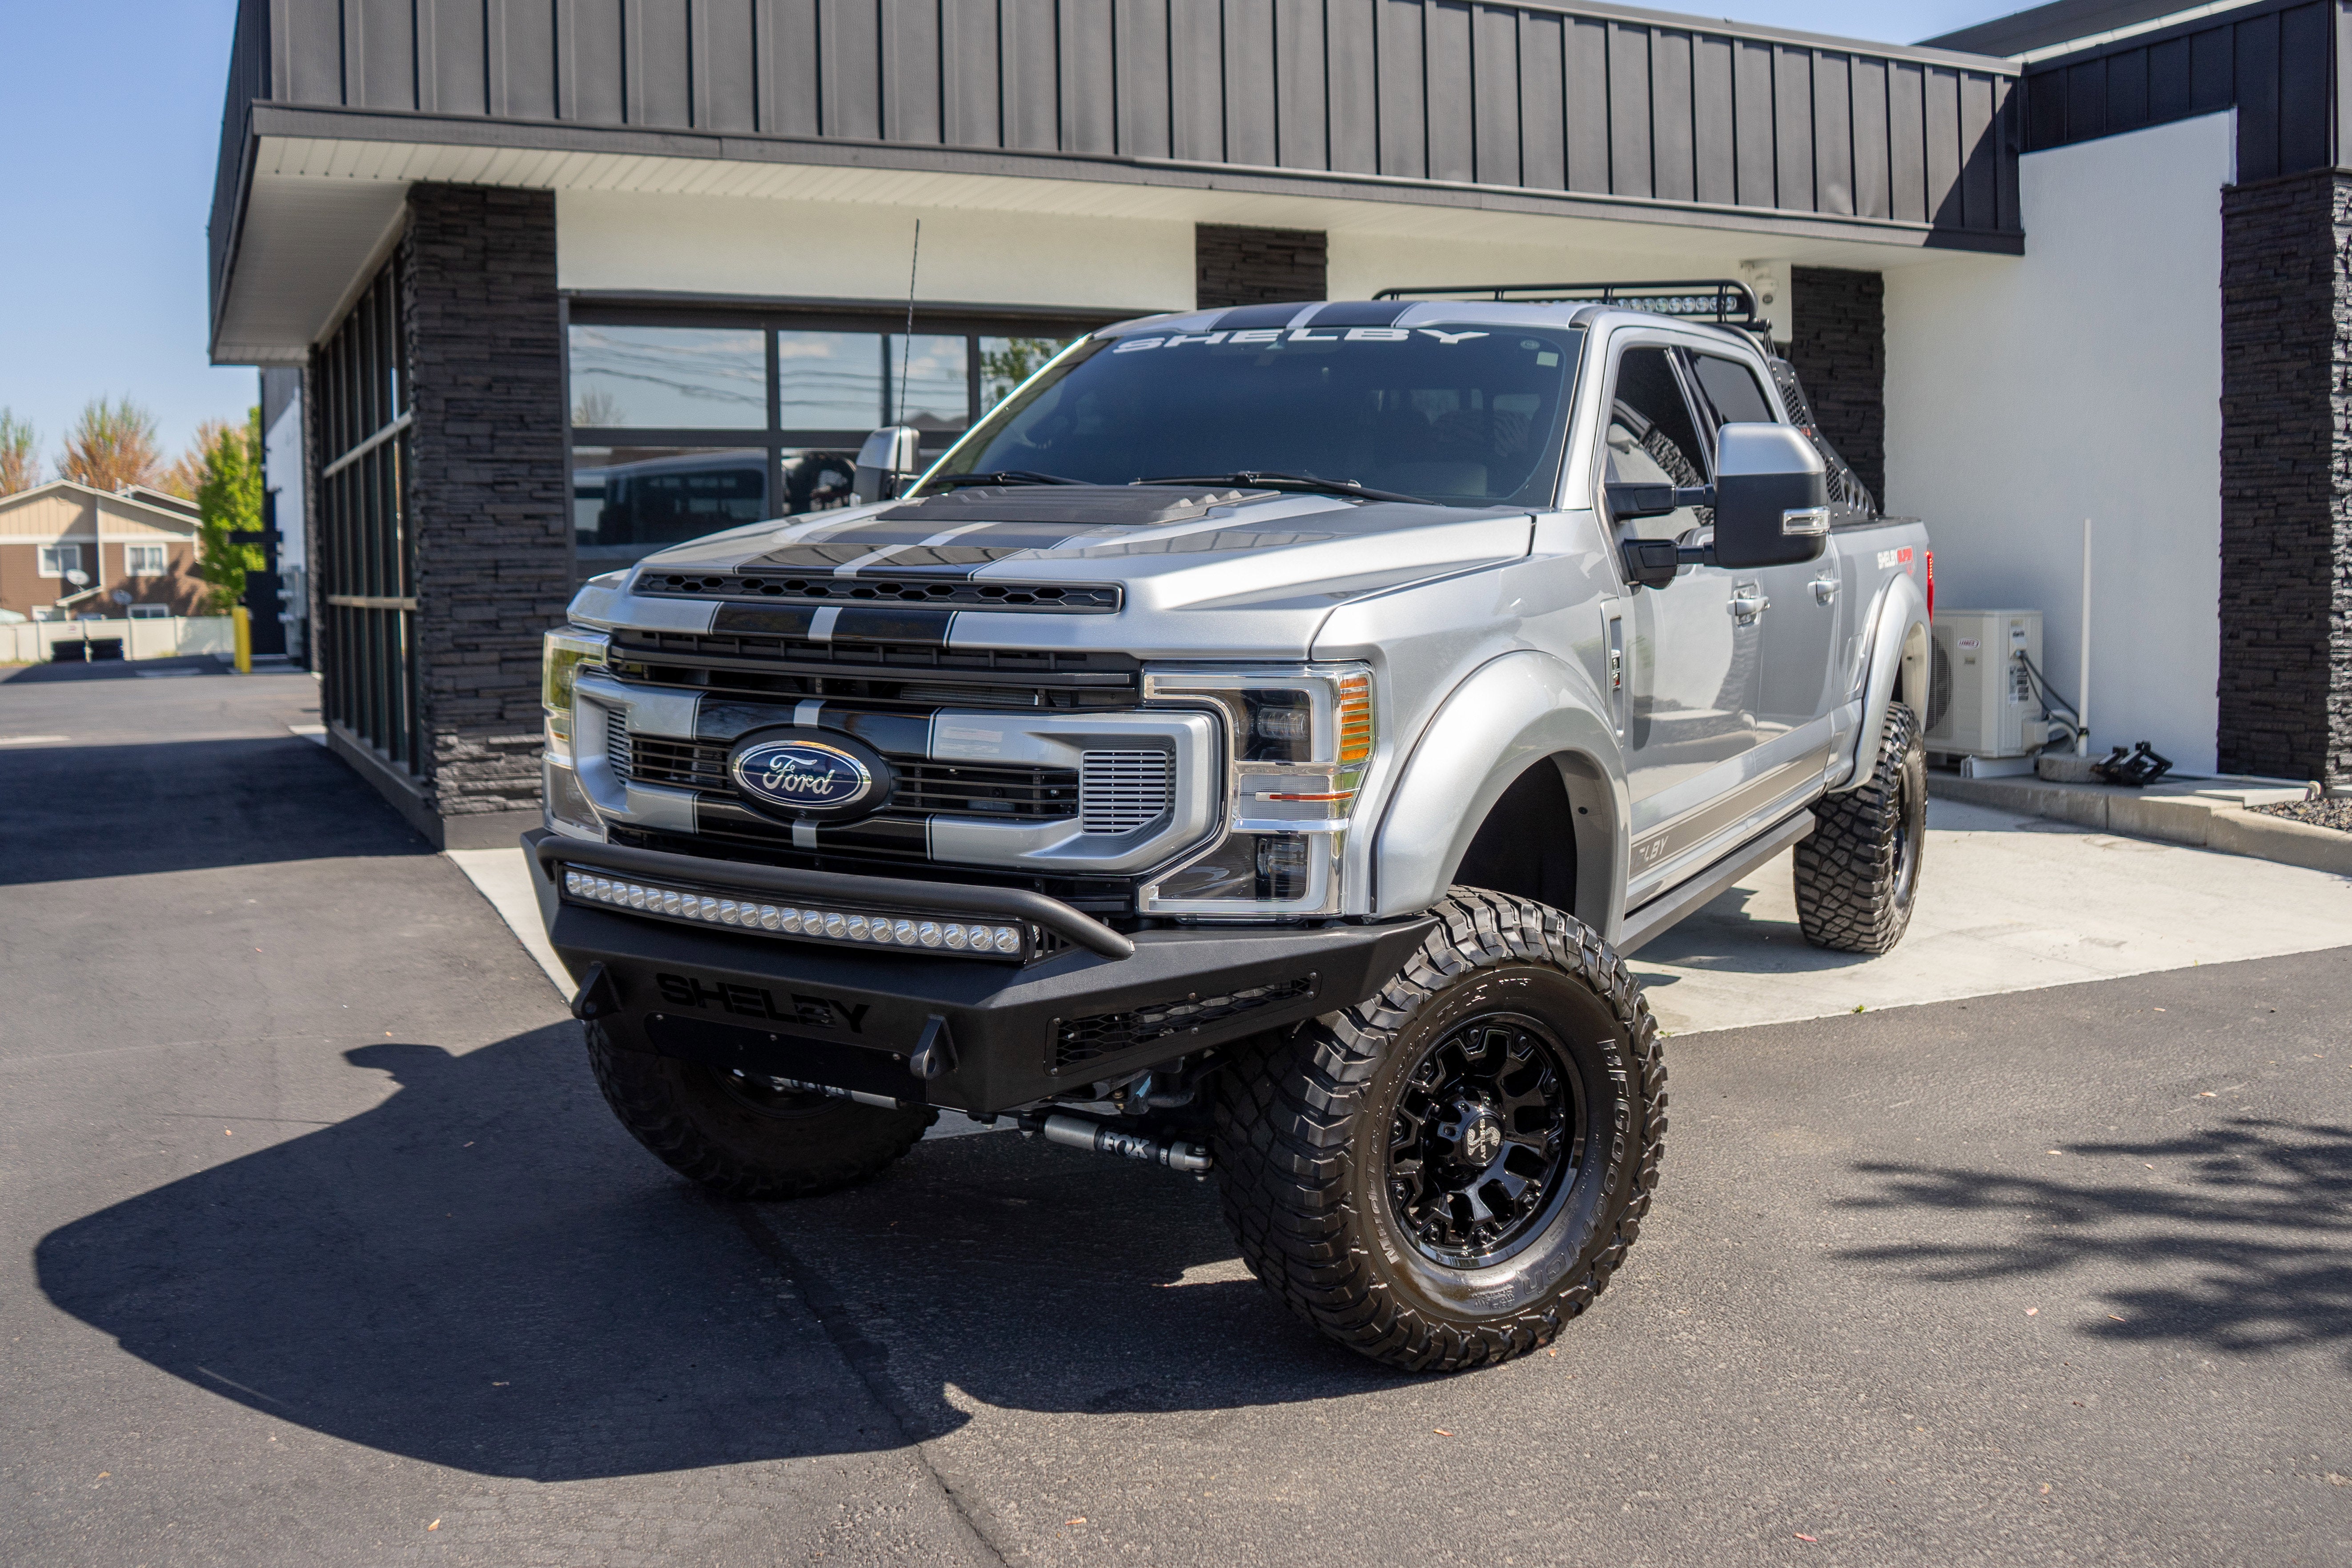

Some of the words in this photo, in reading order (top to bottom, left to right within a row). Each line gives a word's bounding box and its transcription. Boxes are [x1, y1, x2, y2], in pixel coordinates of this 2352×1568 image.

[1113, 329, 1490, 354] SHELBY
[762, 754, 835, 794] Ford
[656, 973, 870, 1033] SHELBY
[1103, 1131, 1150, 1159] FOX
